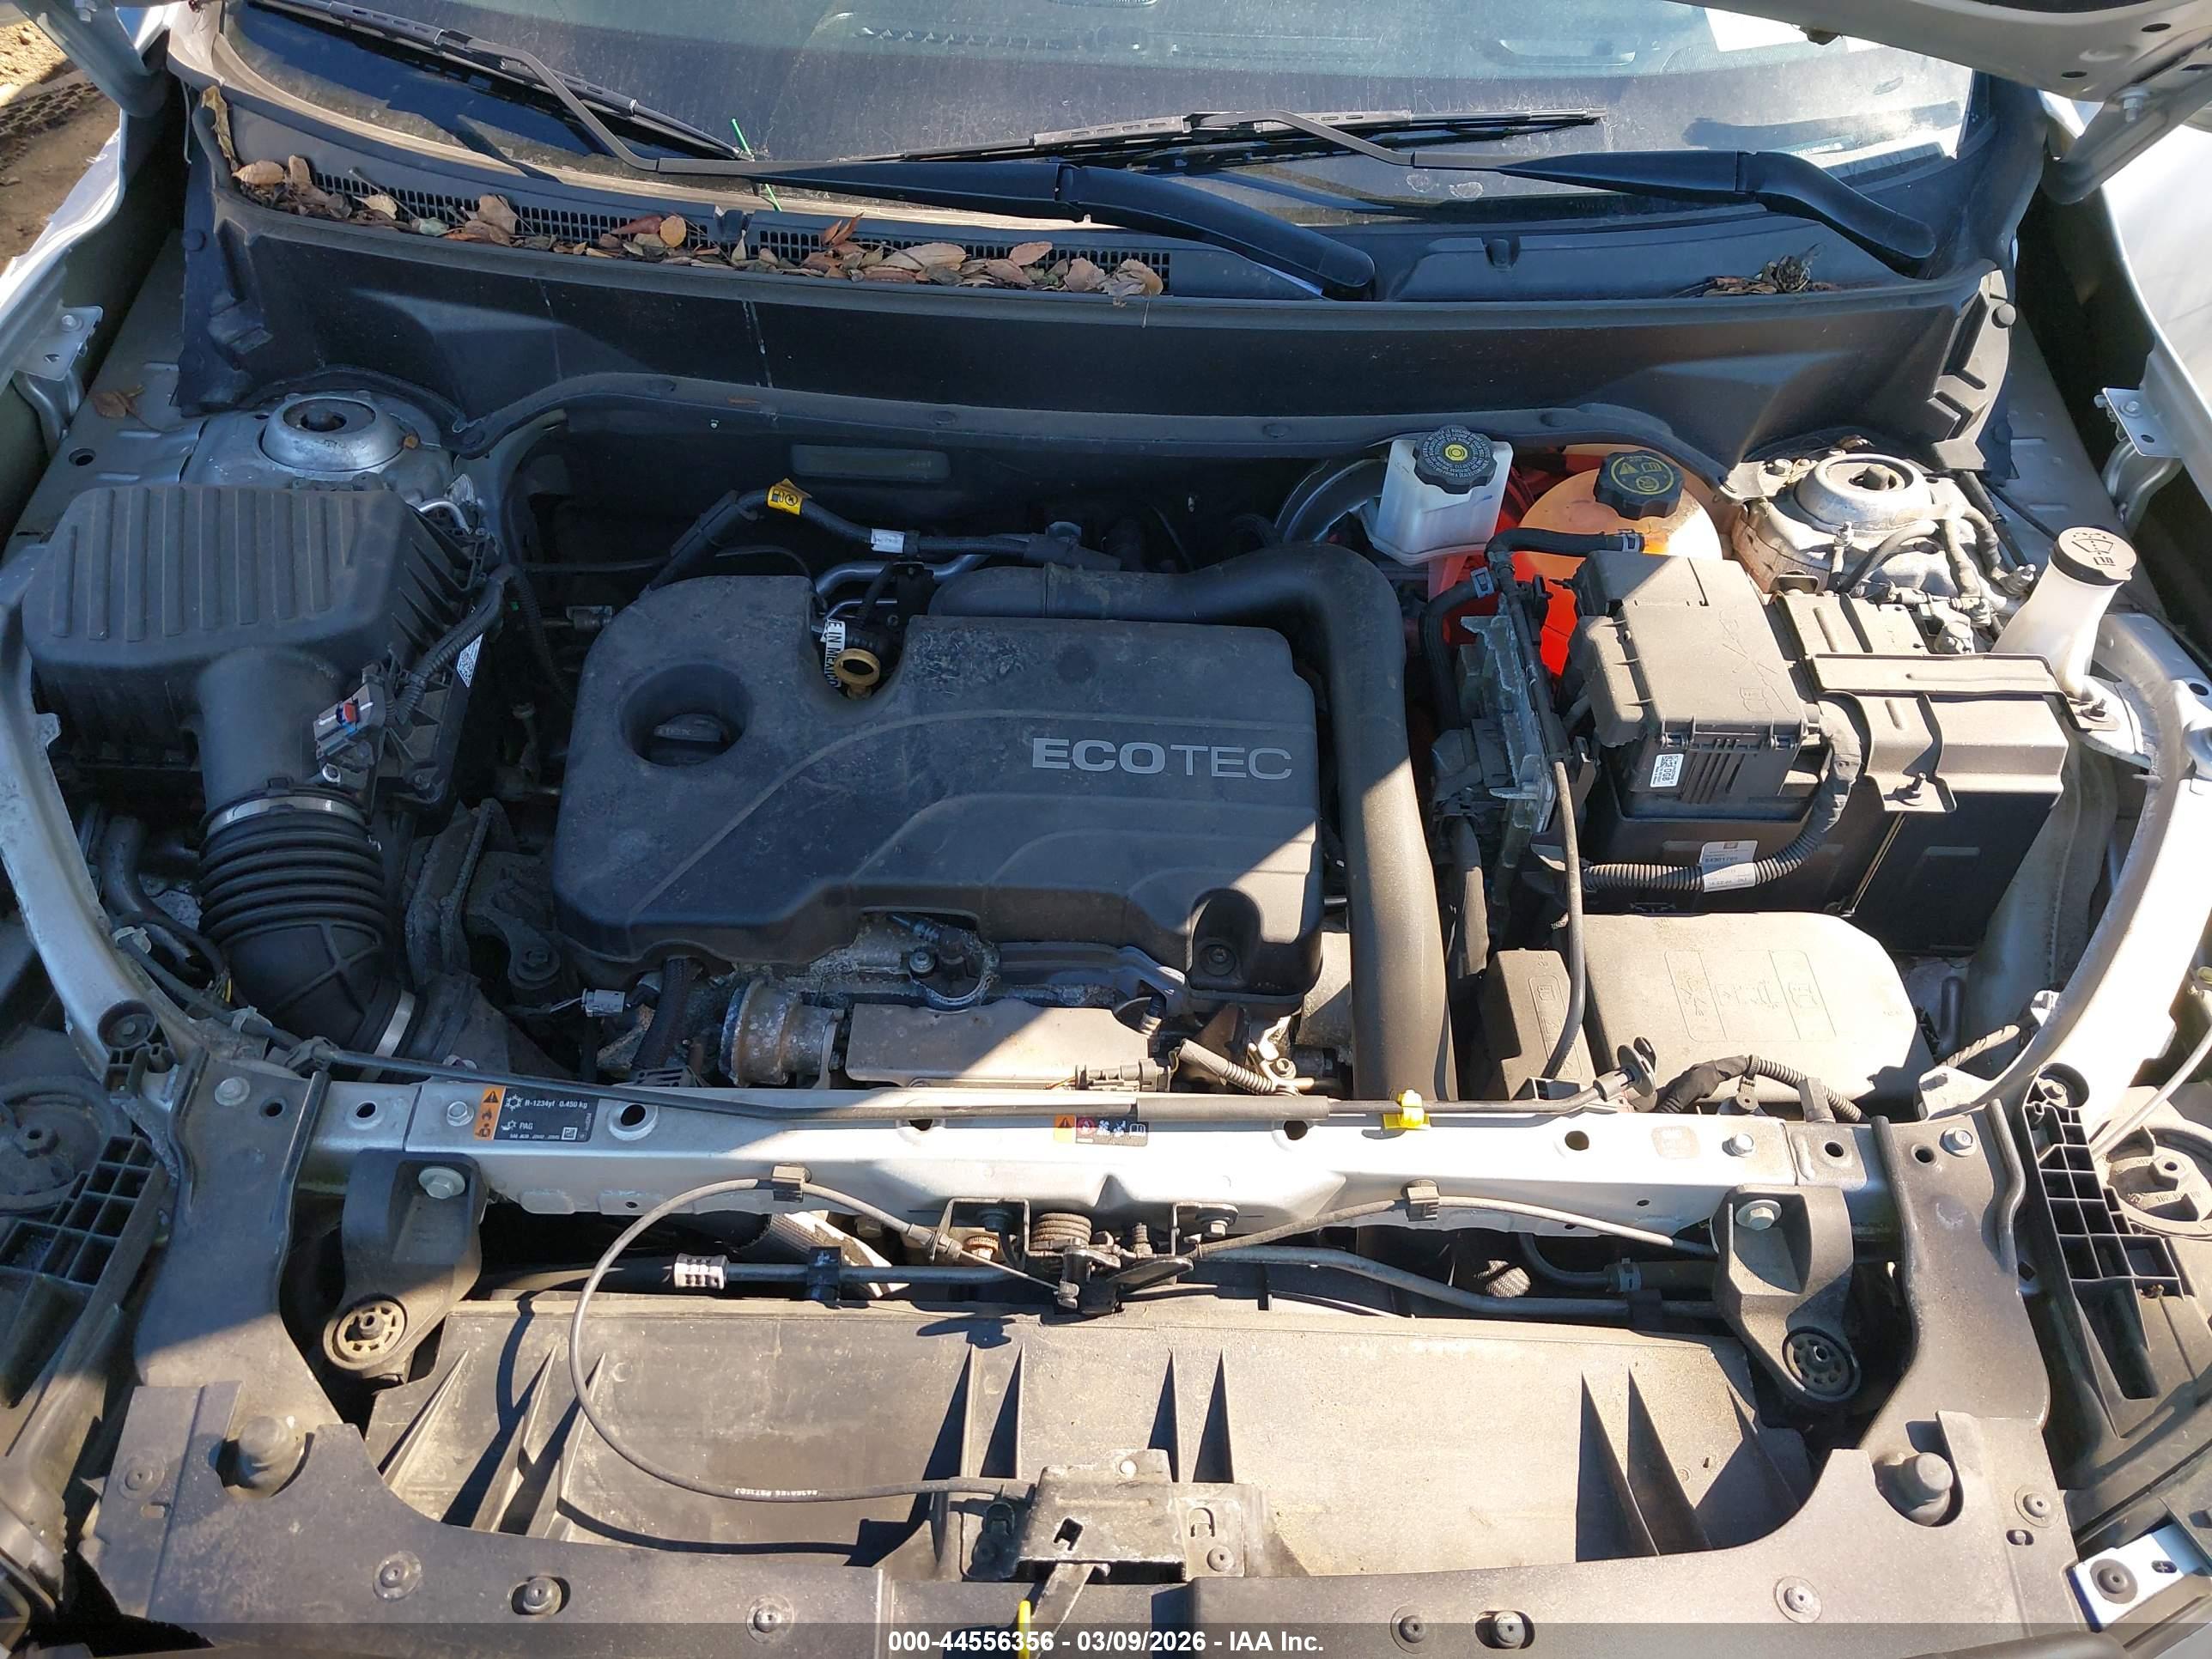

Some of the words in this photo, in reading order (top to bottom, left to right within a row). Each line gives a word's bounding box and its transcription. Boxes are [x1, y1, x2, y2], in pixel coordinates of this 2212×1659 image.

[828, 631, 842, 643] IN
[1032, 738, 1292, 780] ECOTEC
[525, 1098, 556, 1109] R-1234yf
[578, 1101, 588, 1109] kg
[519, 1121, 533, 1130] PAG
